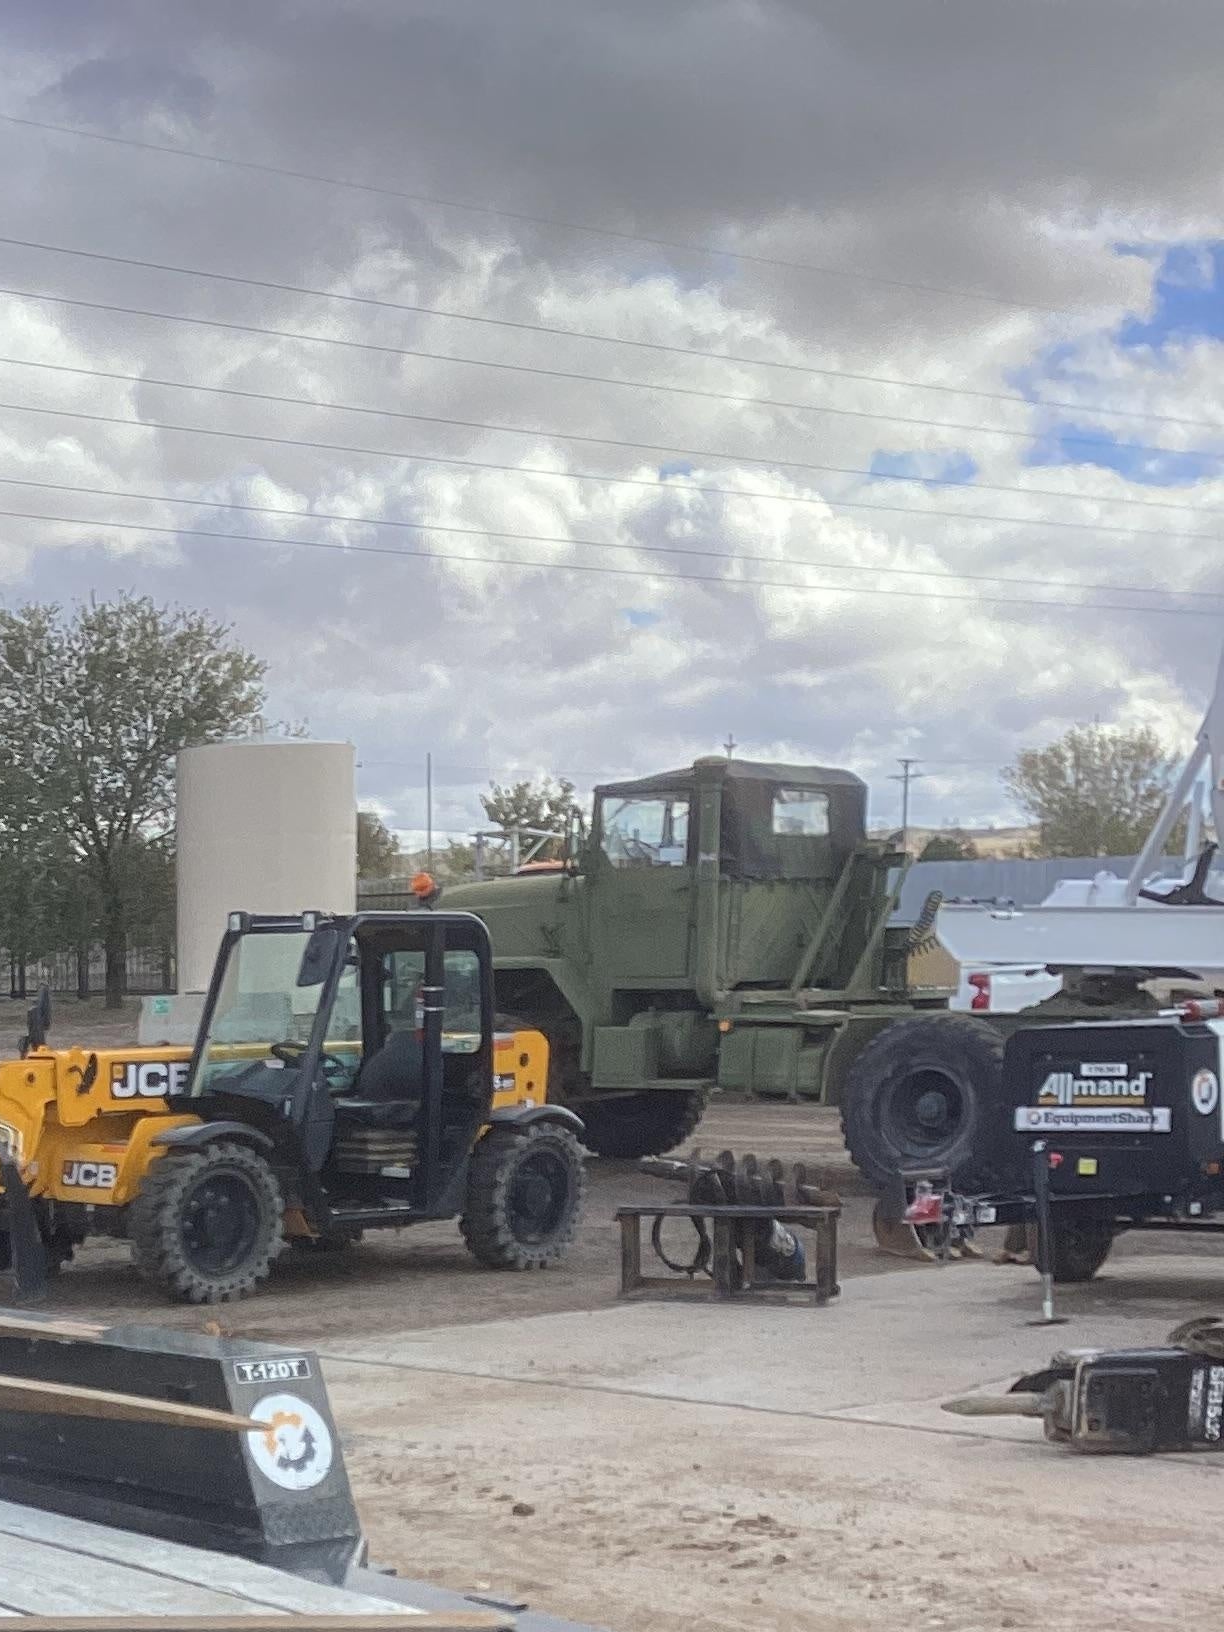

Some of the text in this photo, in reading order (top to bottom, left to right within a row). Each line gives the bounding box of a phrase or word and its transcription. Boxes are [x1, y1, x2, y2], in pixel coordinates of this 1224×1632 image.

[1039, 1072, 1153, 1105] Almand
[1043, 1112, 1159, 1127] EquipmentShare
[62, 1162, 116, 1188] JCB
